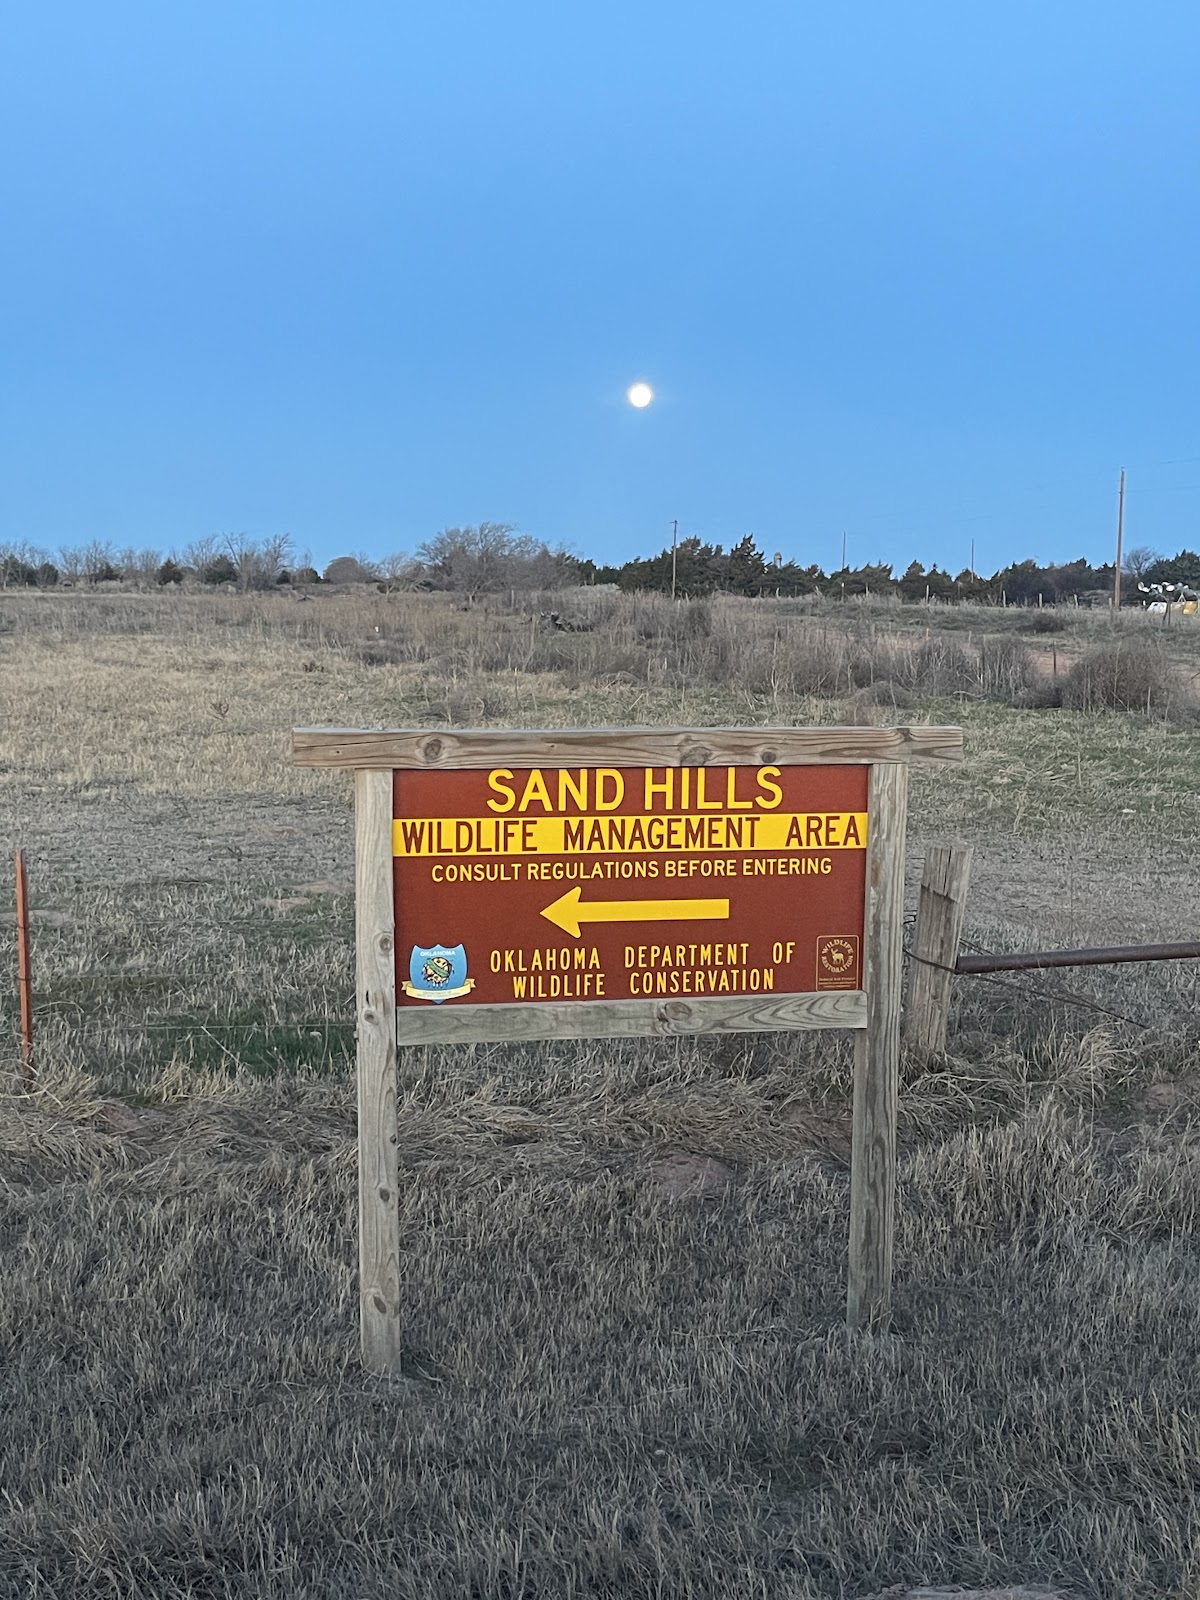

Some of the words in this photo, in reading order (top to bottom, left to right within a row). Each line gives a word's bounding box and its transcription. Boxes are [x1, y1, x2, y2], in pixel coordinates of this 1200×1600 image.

[486, 768, 625, 813] SAND
[644, 765, 783, 811] HILLS
[401, 819, 538, 854] WILDLIFE
[563, 816, 761, 851] MANAGEMENT
[785, 815, 861, 847] AREA
[431, 863, 522, 883] CONSULT
[527, 860, 659, 881] REGULATIONS
[664, 859, 738, 878] BEFORE
[742, 857, 832, 876] ENTERING
[490, 947, 601, 973] OKLAHOMA
[624, 943, 749, 968] DEPARTMENT
[772, 941, 796, 964] OF
[821, 939, 854, 955] WILDLIFE
[512, 973, 606, 999] WILDLIFE
[629, 968, 774, 995] CONSERVATION
